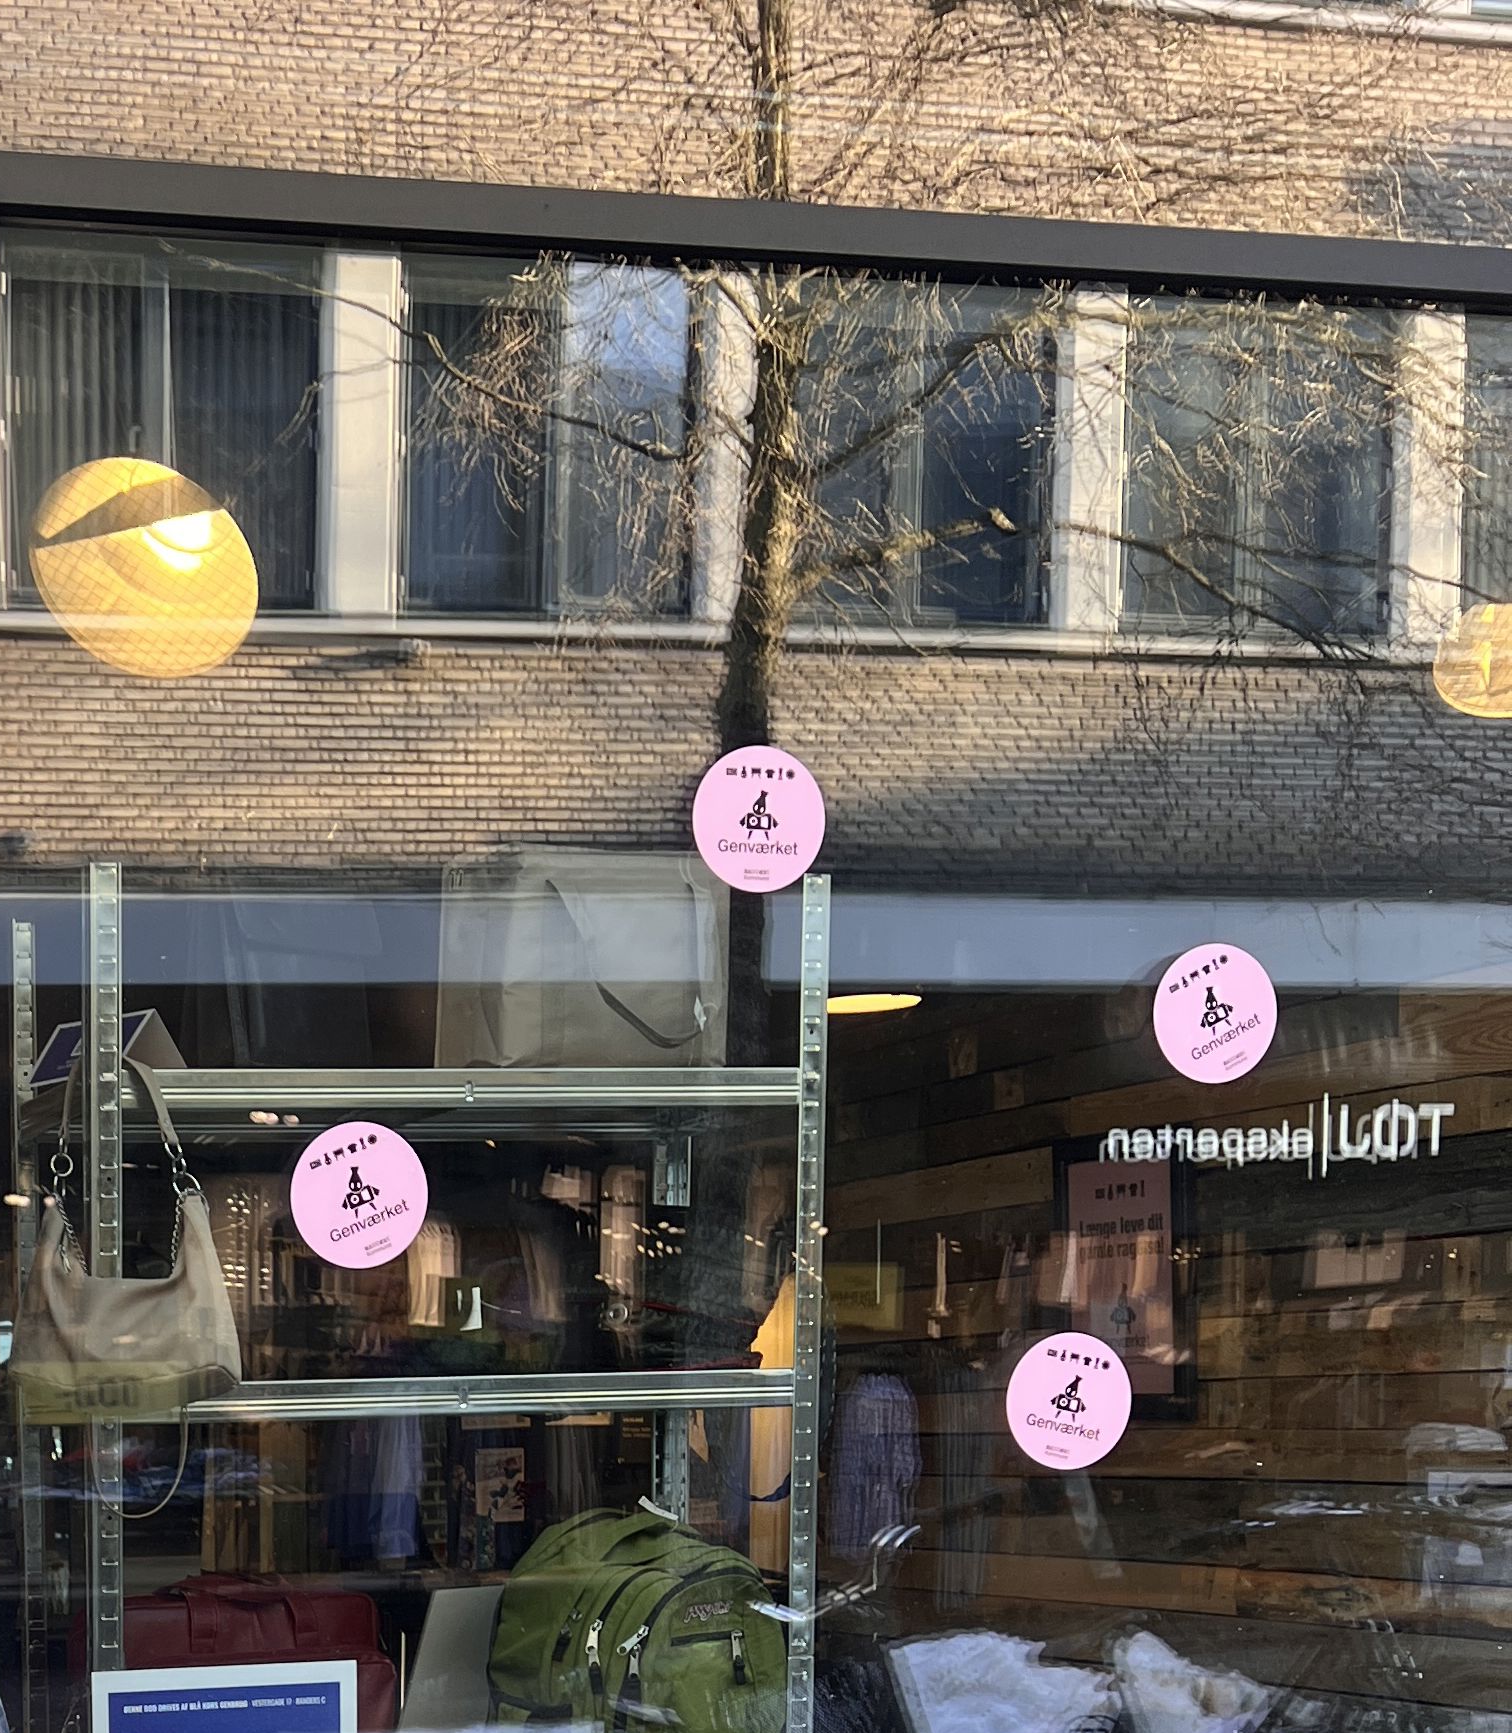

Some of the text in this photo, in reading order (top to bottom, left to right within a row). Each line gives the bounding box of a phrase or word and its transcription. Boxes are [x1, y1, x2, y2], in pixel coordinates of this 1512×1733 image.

[717, 838, 799, 856] Genværket
[1190, 1013, 1262, 1061] Genværket
[329, 1199, 410, 1242] Genværket
[1026, 1413, 1101, 1442] Genværket
